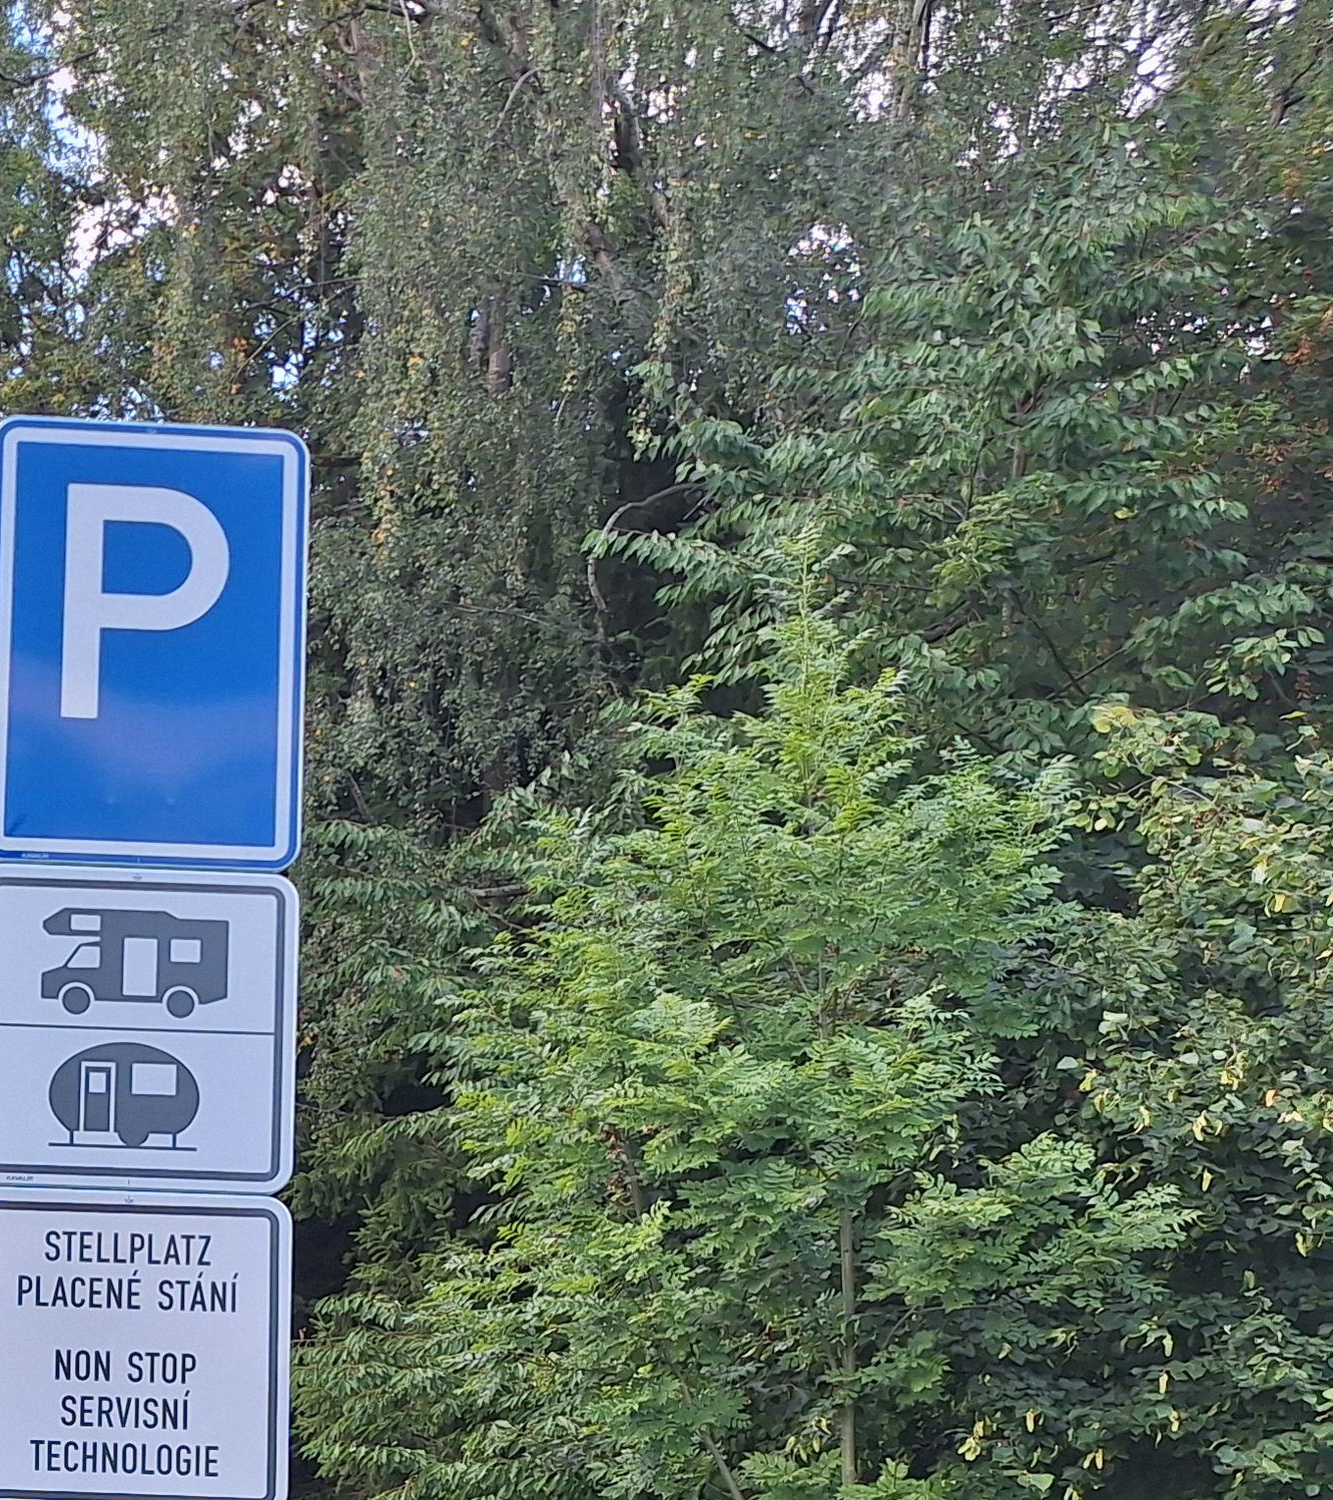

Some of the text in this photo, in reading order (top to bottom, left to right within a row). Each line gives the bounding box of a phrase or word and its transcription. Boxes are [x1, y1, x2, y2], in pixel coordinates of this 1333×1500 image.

[61, 483, 229, 718] P
[45, 1230, 212, 1266] STELLPLATZ
[17, 1270, 238, 1312] PLACENÉ STÁNÍ
[54, 1349, 197, 1384] NON STOP
[61, 1390, 190, 1430] SERVISNÍ
[30, 1439, 219, 1477] TECHNOLOGIE
